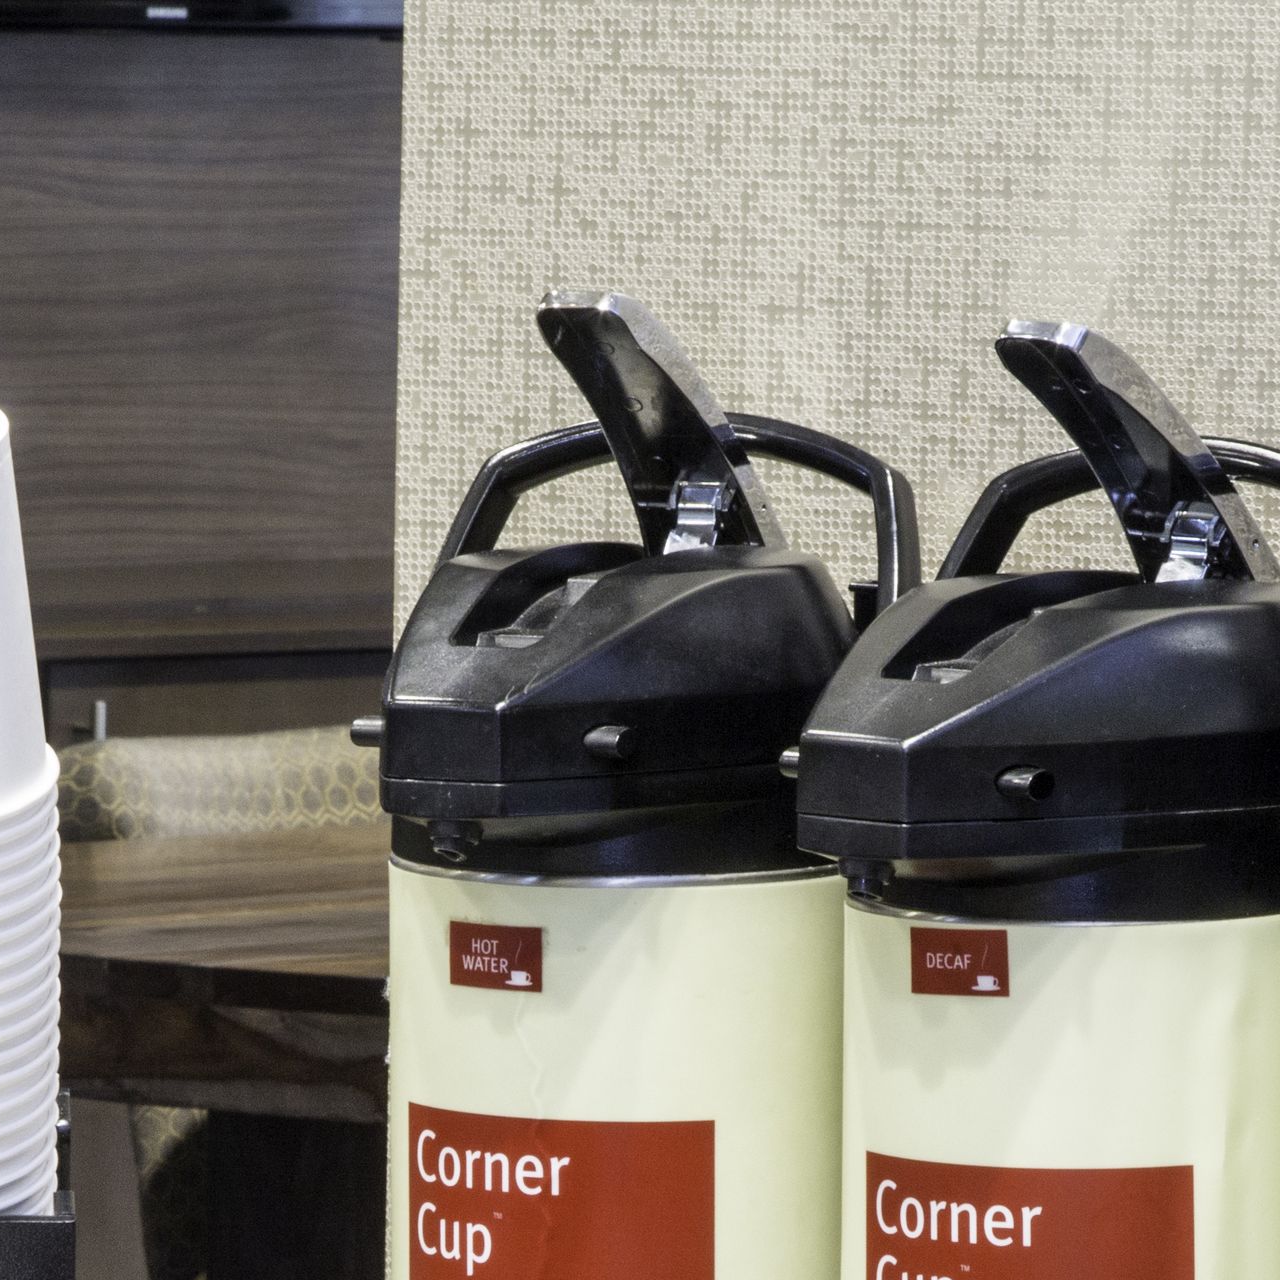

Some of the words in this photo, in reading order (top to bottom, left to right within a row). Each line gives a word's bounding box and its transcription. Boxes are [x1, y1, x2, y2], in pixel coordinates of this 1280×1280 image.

[471, 937, 499, 955] HOT
[462, 954, 509, 974] WATER
[926, 951, 972, 970] DECAF
[417, 1128, 571, 1197] Corner
[875, 1179, 1043, 1248] Corner
